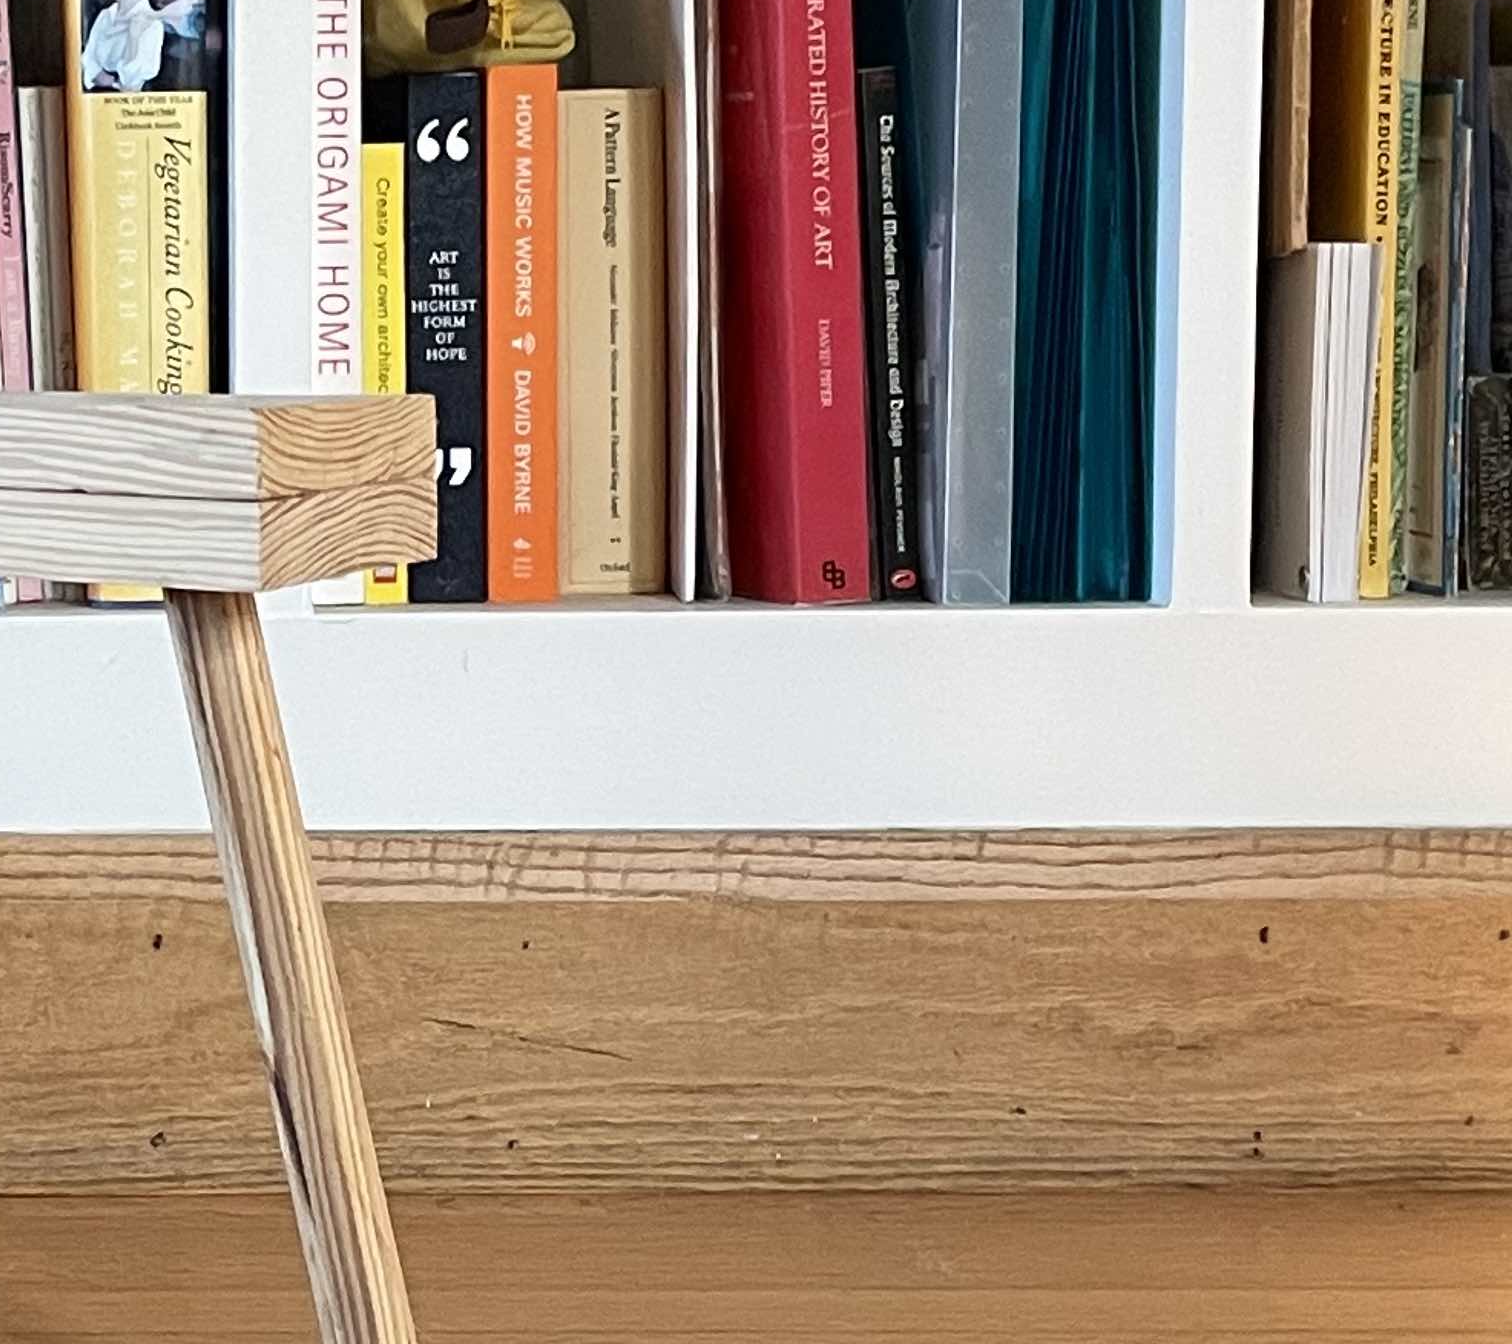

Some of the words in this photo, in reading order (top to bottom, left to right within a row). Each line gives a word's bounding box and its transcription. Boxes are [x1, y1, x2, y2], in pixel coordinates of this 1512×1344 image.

[1378, 85, 1392, 105] IN
[514, 94, 532, 150] HOW
[809, 81, 829, 179] HISTORY
[880, 114, 894, 142] The
[317, 77, 350, 244] ORIGAMI
[603, 120, 617, 175] Pattern
[881, 145, 896, 198] Sources
[1377, 112, 1391, 225] EDUCATION
[155, 137, 192, 275] Vegetarian
[375, 178, 390, 235] Create
[515, 158, 534, 230] MUSIC
[602, 180, 617, 247] Language
[813, 186, 831, 217] OF
[882, 202, 896, 214] of
[374, 242, 388, 277] your
[428, 250, 459, 264] ART
[814, 223, 833, 270] ART
[883, 219, 898, 275] Modern
[430, 283, 460, 296] THE
[438, 268, 451, 280] IS
[514, 235, 534, 319] WORKS
[317, 265, 350, 375] HOME
[377, 284, 388, 318] own
[411, 300, 477, 313] HIGHEST
[423, 316, 465, 330] FORM
[884, 280, 900, 364] Architecture
[156, 288, 193, 396] Cooking
[426, 348, 467, 362] HOPE
[435, 332, 455, 345] OF
[818, 319, 832, 364] DAVID
[513, 369, 532, 438] DAVID
[821, 366, 833, 407] PIPER
[888, 367, 902, 394] and
[889, 399, 905, 447] Design
[513, 442, 532, 515] BYRNE
